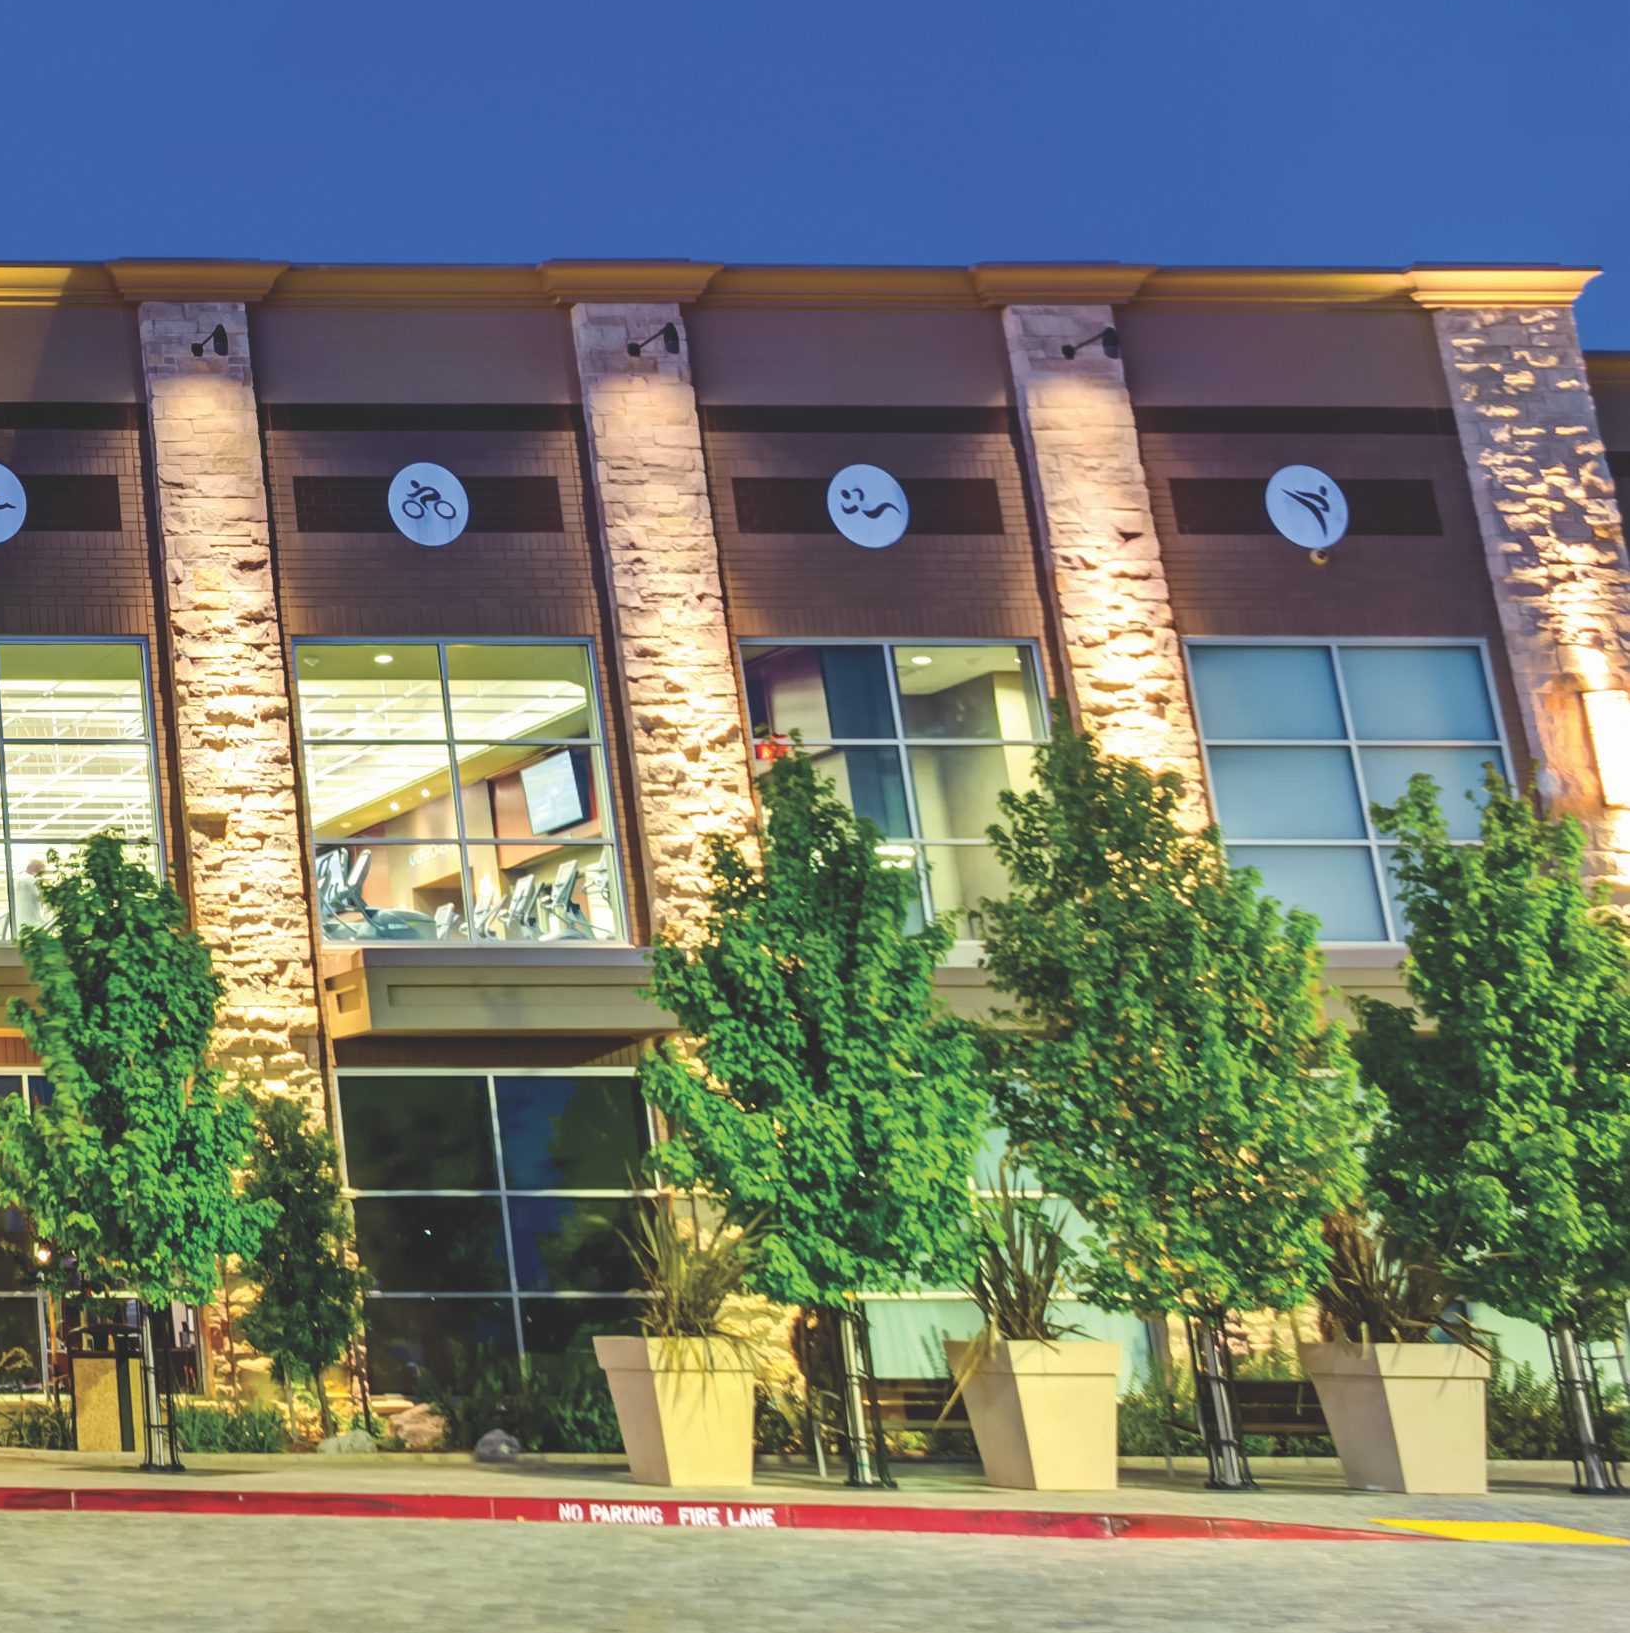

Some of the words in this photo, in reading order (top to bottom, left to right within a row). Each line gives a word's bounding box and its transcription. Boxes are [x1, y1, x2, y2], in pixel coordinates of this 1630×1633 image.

[558, 1502, 583, 1522] NO
[590, 1503, 664, 1525] PARKING
[678, 1506, 722, 1527] FIRE
[726, 1506, 777, 1528] LANE
